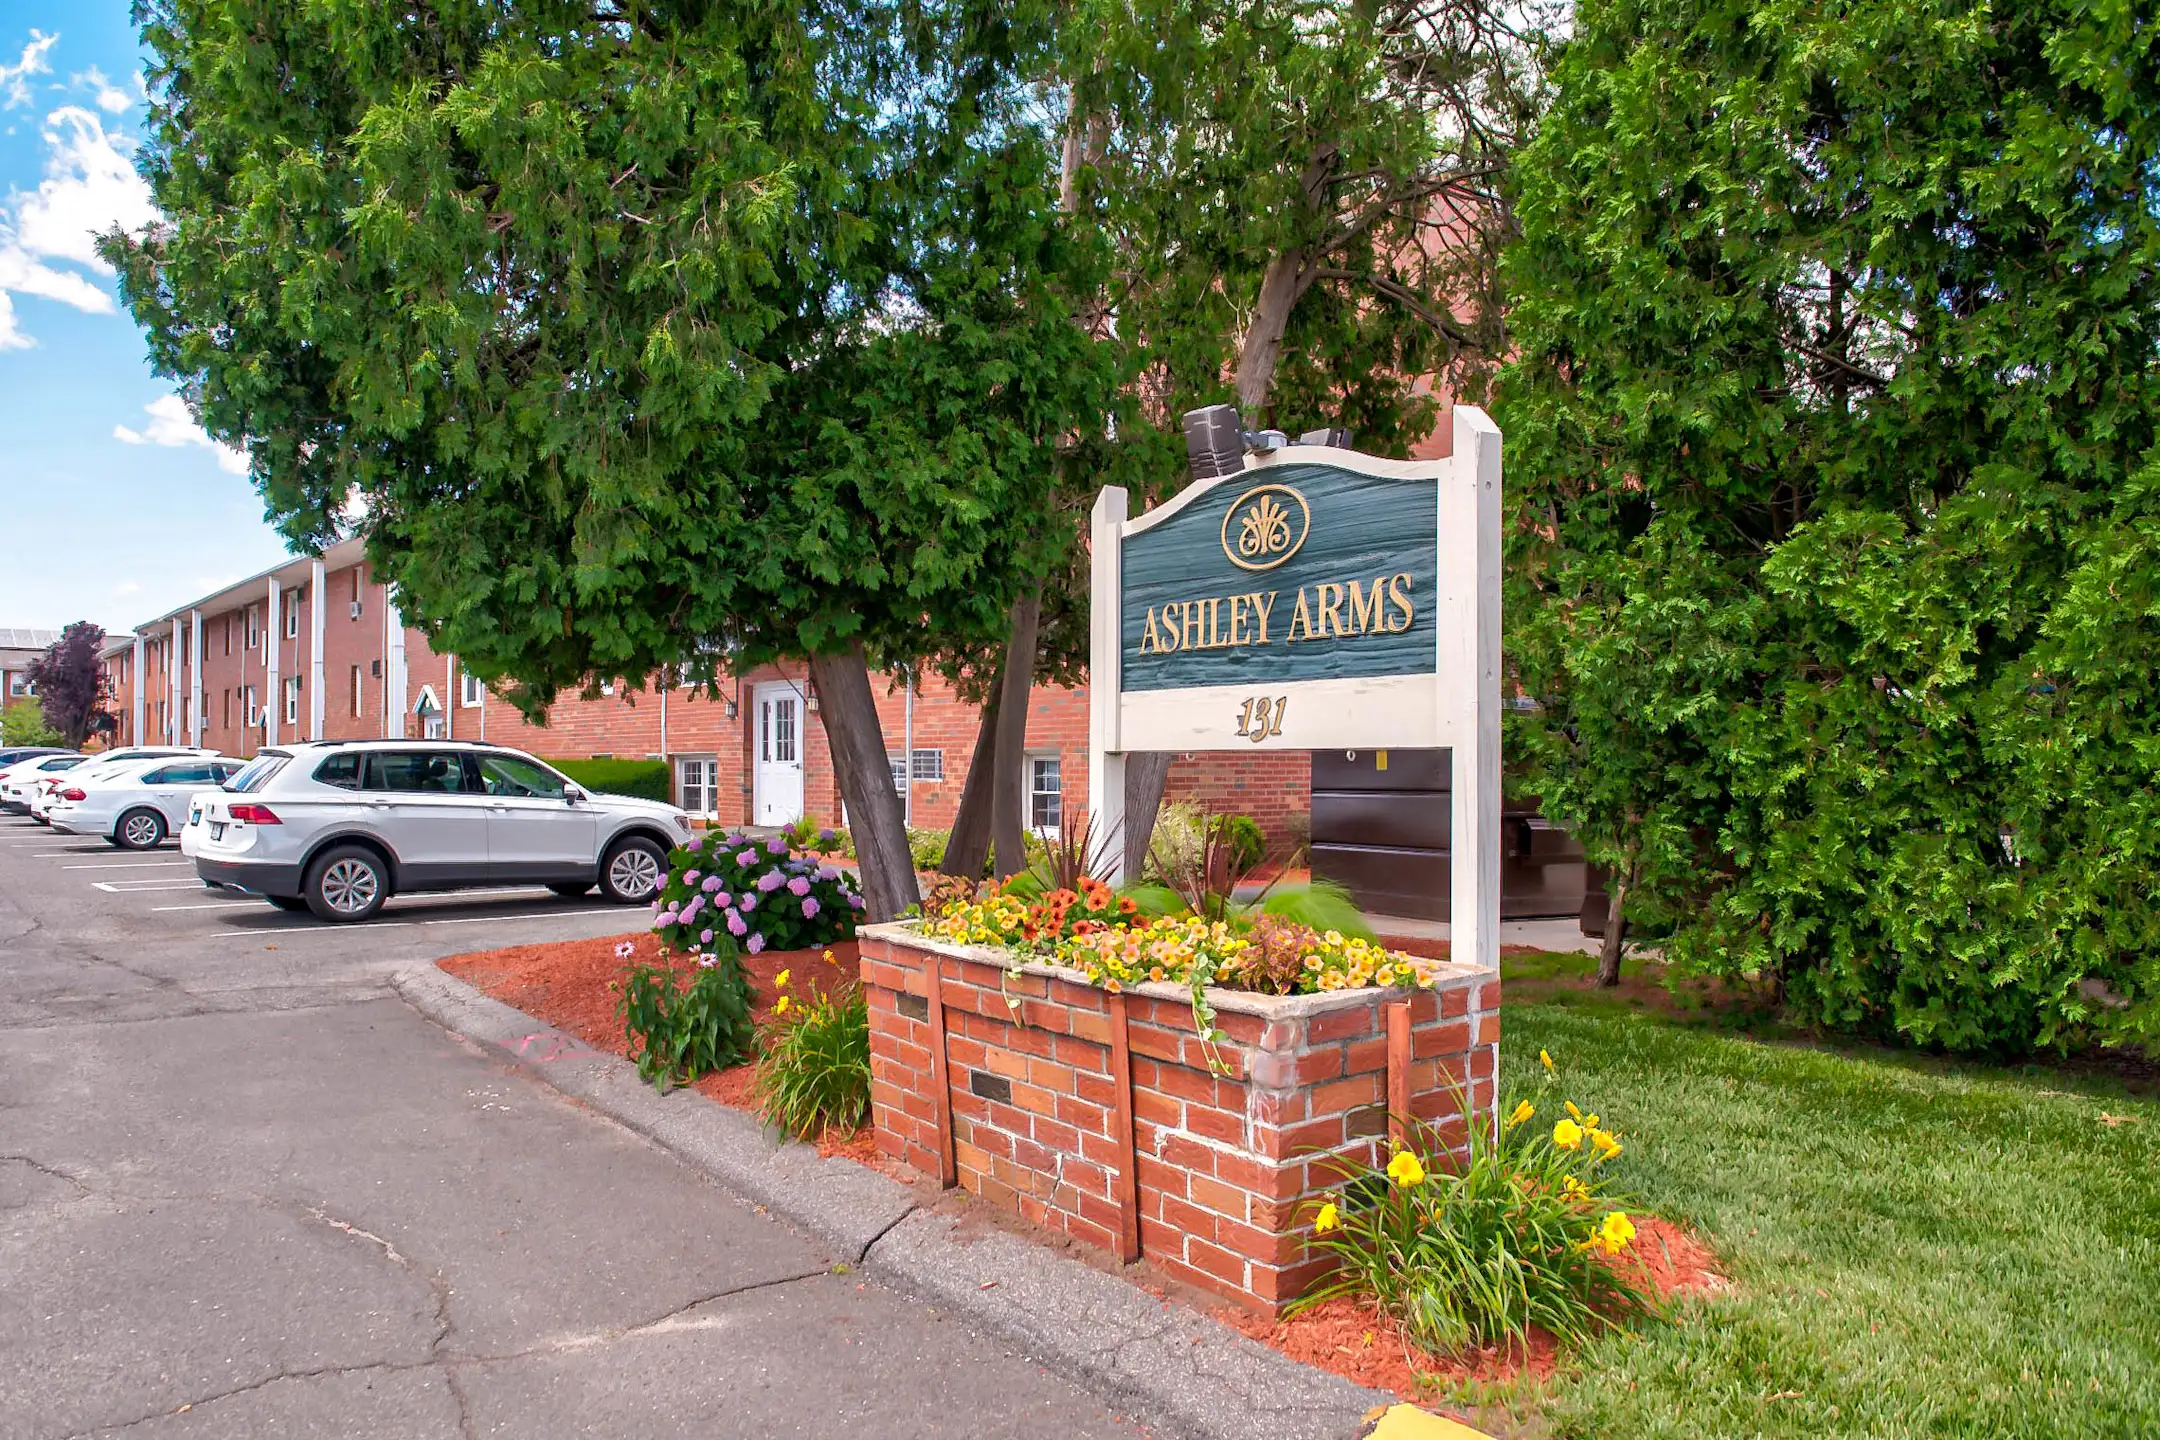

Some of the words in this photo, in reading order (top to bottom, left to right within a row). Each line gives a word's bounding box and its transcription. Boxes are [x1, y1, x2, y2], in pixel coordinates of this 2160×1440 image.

[1140, 590, 1279, 655] ASHLEY
[1288, 573, 1414, 642] ARMS
[1236, 696, 1287, 743] 131
